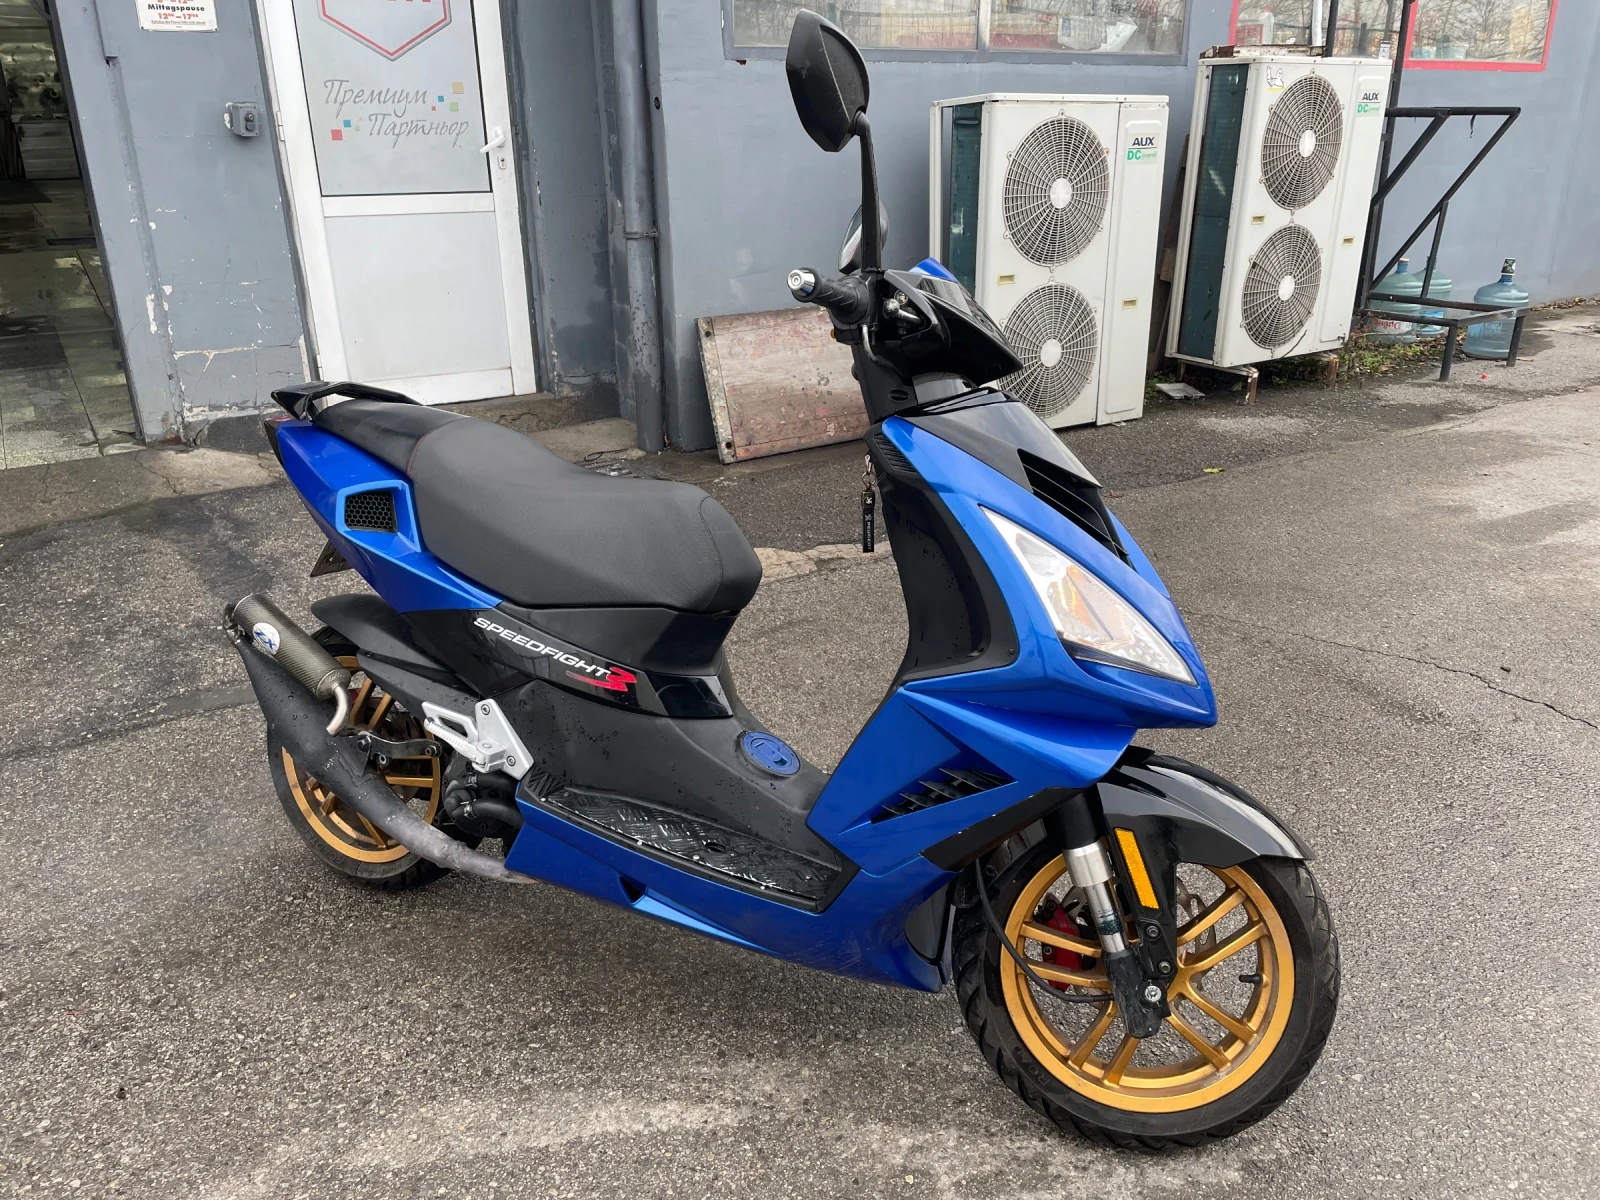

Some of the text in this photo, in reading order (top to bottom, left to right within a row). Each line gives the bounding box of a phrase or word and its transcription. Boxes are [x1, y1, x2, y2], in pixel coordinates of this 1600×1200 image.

[147, 4, 205, 12] Mittagspause
[323, 79, 428, 119] Премиум
[1362, 92, 1380, 101] AUX
[1357, 104, 1369, 113] DC
[368, 113, 469, 149] Партньор
[1132, 136, 1155, 146] AUX
[1126, 150, 1142, 160] DC
[473, 616, 613, 677] SPEEDFIGHT
